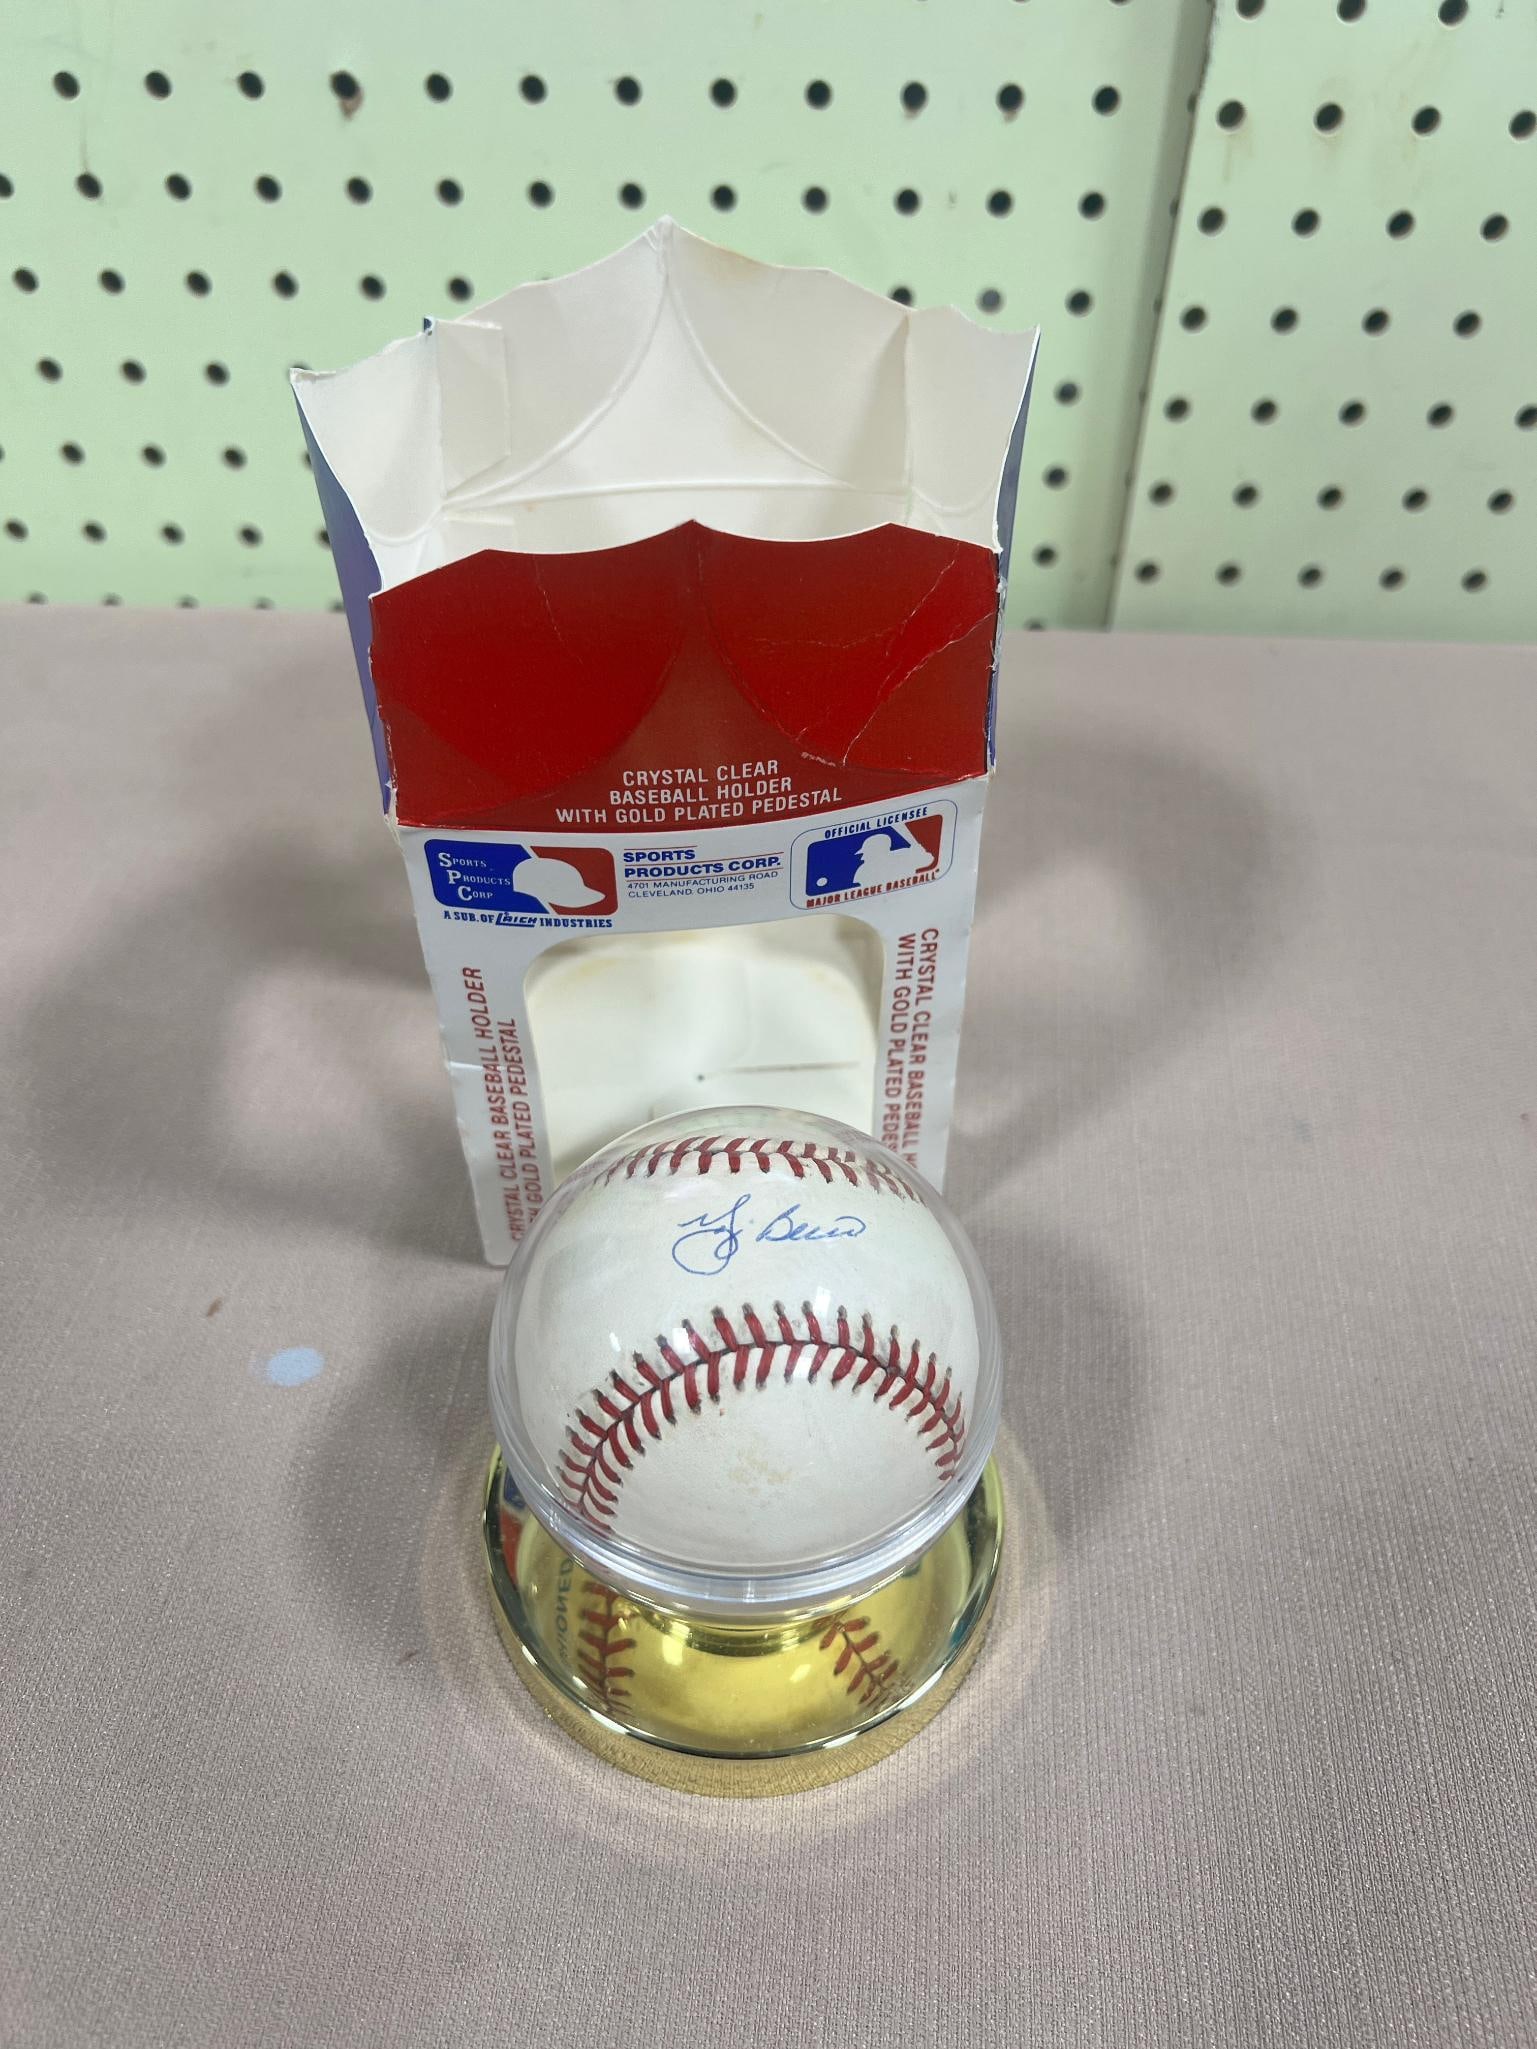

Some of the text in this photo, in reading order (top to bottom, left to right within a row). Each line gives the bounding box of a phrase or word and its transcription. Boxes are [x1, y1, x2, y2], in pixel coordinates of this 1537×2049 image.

[610, 777, 792, 805] BASEBALL HOLDER
[623, 760, 778, 787] CRYSTAL CLEAR
[556, 787, 842, 823] WITH GOLD PLATED PEDESTAL
[824, 807, 928, 839] OFFICIAL LICENSEE
[438, 852, 487, 868] SPORTS
[623, 849, 696, 863] SPORTS
[624, 856, 781, 878] PRODUCTS CORP.
[447, 869, 511, 886] PRODUCTS
[627, 871, 779, 890] 4701 MANUFACTURING ROAD
[697, 886, 725, 895] OHIO
[727, 883, 755, 892] 44135
[806, 894, 841, 908] MAJOR
[844, 884, 882, 900] LEAGUE
[443, 910, 451, 920] A
[540, 917, 613, 928] INDUSTRIES
[895, 933, 916, 980] WITH
[914, 928, 939, 1006] CRYSTAL
[462, 967, 494, 1039] HOLDER
[890, 986, 911, 1033] GOLD
[908, 1011, 931, 1064] CLEAR
[497, 1018, 528, 1096] PEDESTAL
[885, 1038, 906, 1098] PLATED
[479, 1045, 509, 1125] BASEBALL
[902, 1070, 925, 1149] BASEBALL
[513, 1101, 537, 1158] PLATED
[493, 1131, 518, 1181] CLEAR
[522, 1163, 544, 1203] GOLD
